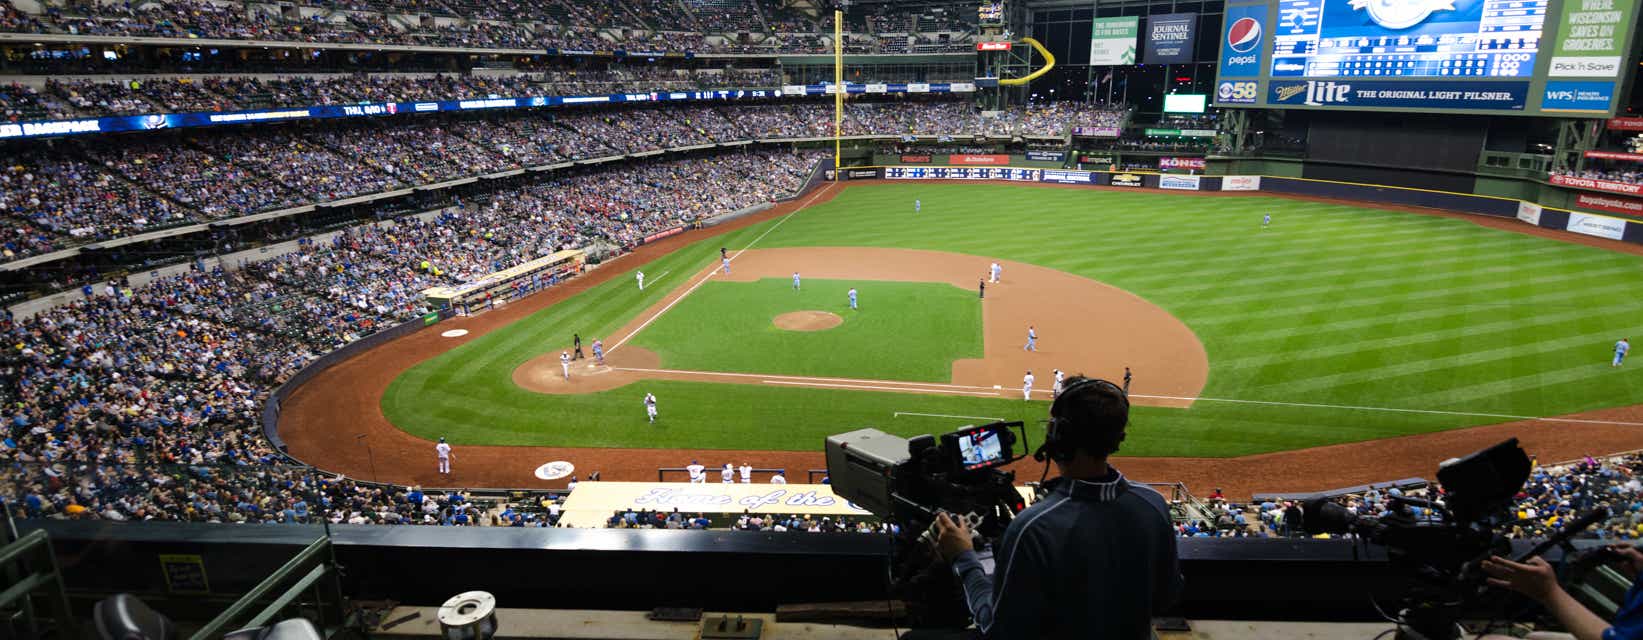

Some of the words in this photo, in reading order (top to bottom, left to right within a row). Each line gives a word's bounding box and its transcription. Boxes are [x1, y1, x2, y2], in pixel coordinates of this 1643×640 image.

[1582, 0, 1614, 10] WHERE
[1568, 11, 1623, 24] WISCONSIN
[1153, 24, 1190, 33] JOURNAL
[1569, 25, 1599, 37] SAVES
[1152, 32, 1188, 40] SENTINEL
[1228, 55, 1256, 66] pepsi
[1555, 63, 1576, 71] Pick
[1587, 63, 1614, 71] Save
[1232, 82, 1257, 99] 58
[1275, 84, 1307, 101] Miller
[1304, 80, 1350, 106] Lite
[1356, 90, 1376, 98] THE
[1378, 90, 1427, 99] ORIGINAL
[1429, 91, 1462, 99] LIGHT
[1547, 91, 1573, 100] WPS
[1565, 177, 1595, 188] TOYOTA
[1597, 180, 1640, 192] TERRITORY
[739, 489, 787, 509] of
[785, 490, 836, 507] the
